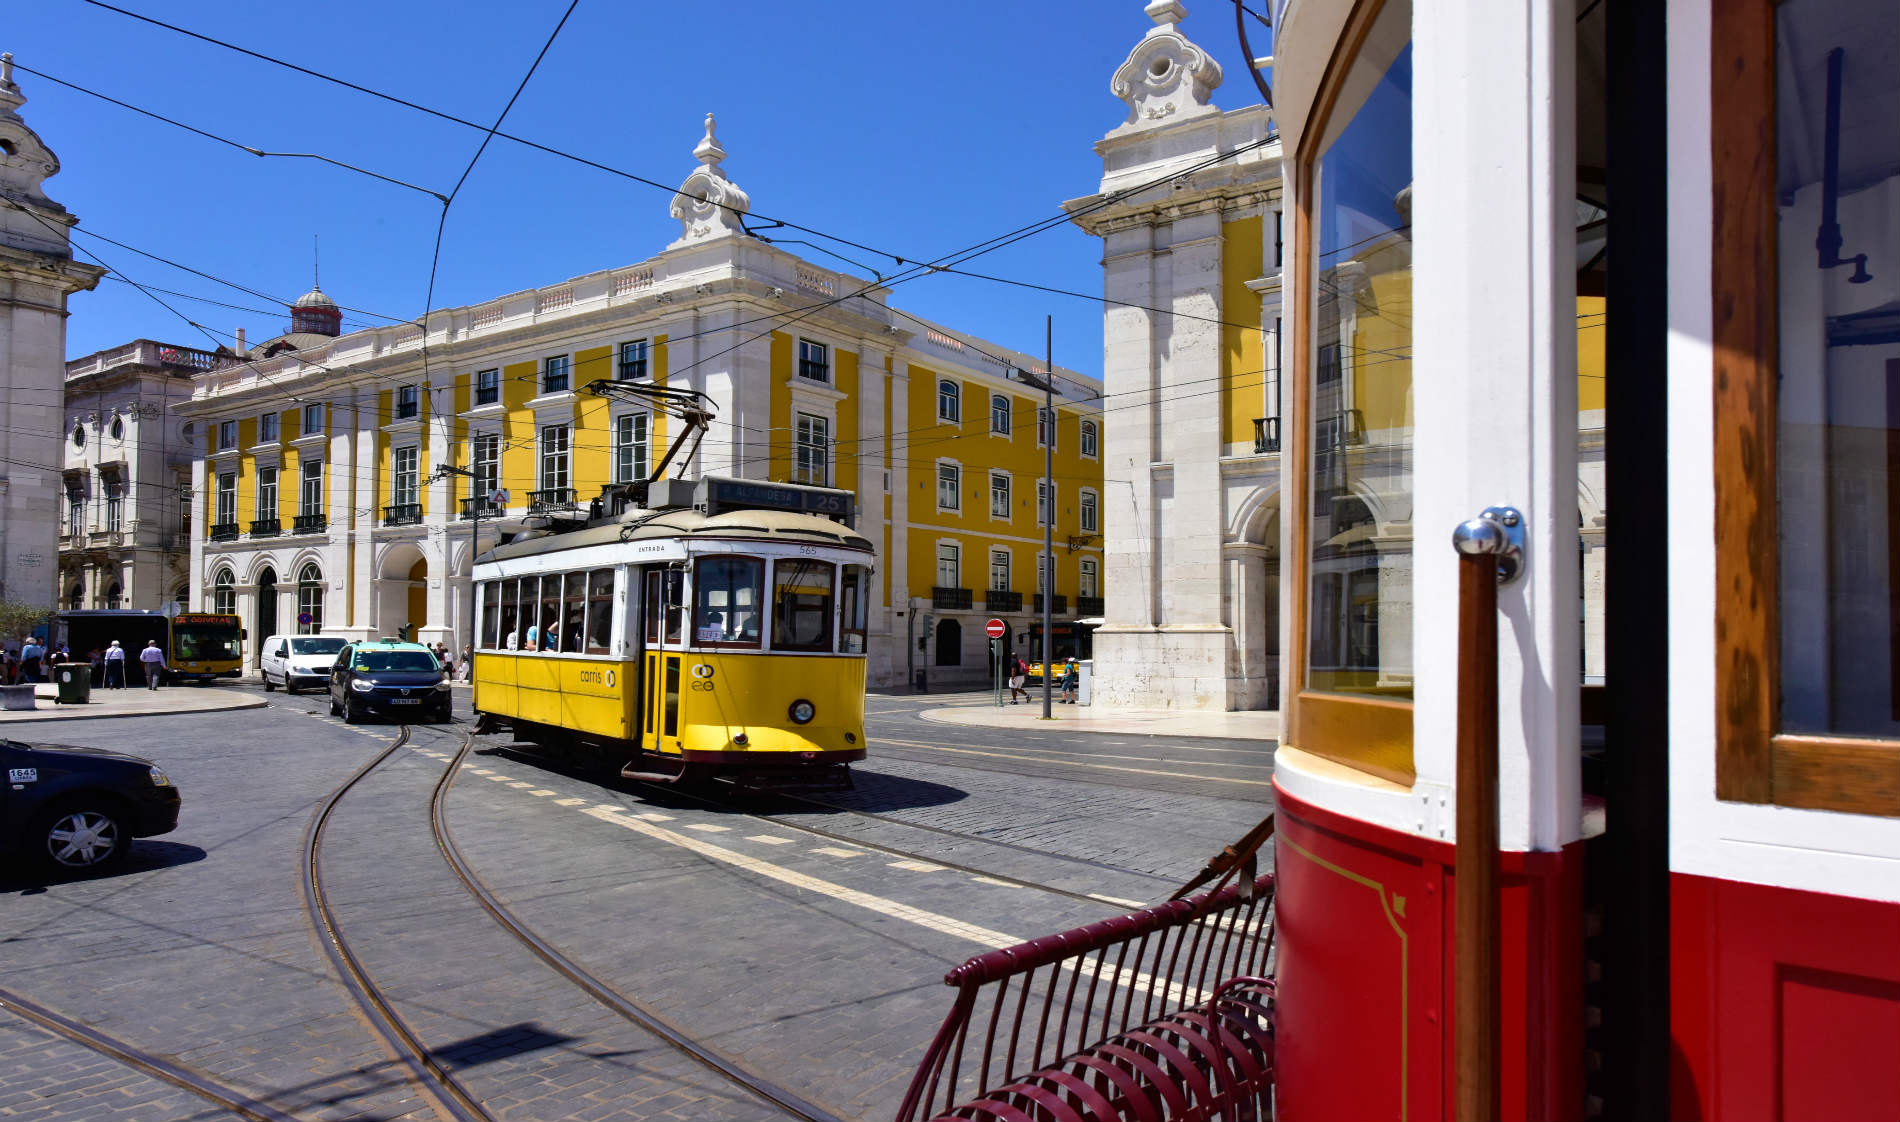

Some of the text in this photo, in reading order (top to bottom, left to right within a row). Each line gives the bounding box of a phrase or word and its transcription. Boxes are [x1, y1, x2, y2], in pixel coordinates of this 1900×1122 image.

[817, 495, 840, 511] 25
[799, 545, 817, 555] 565
[10, 769, 36, 777] 1645
